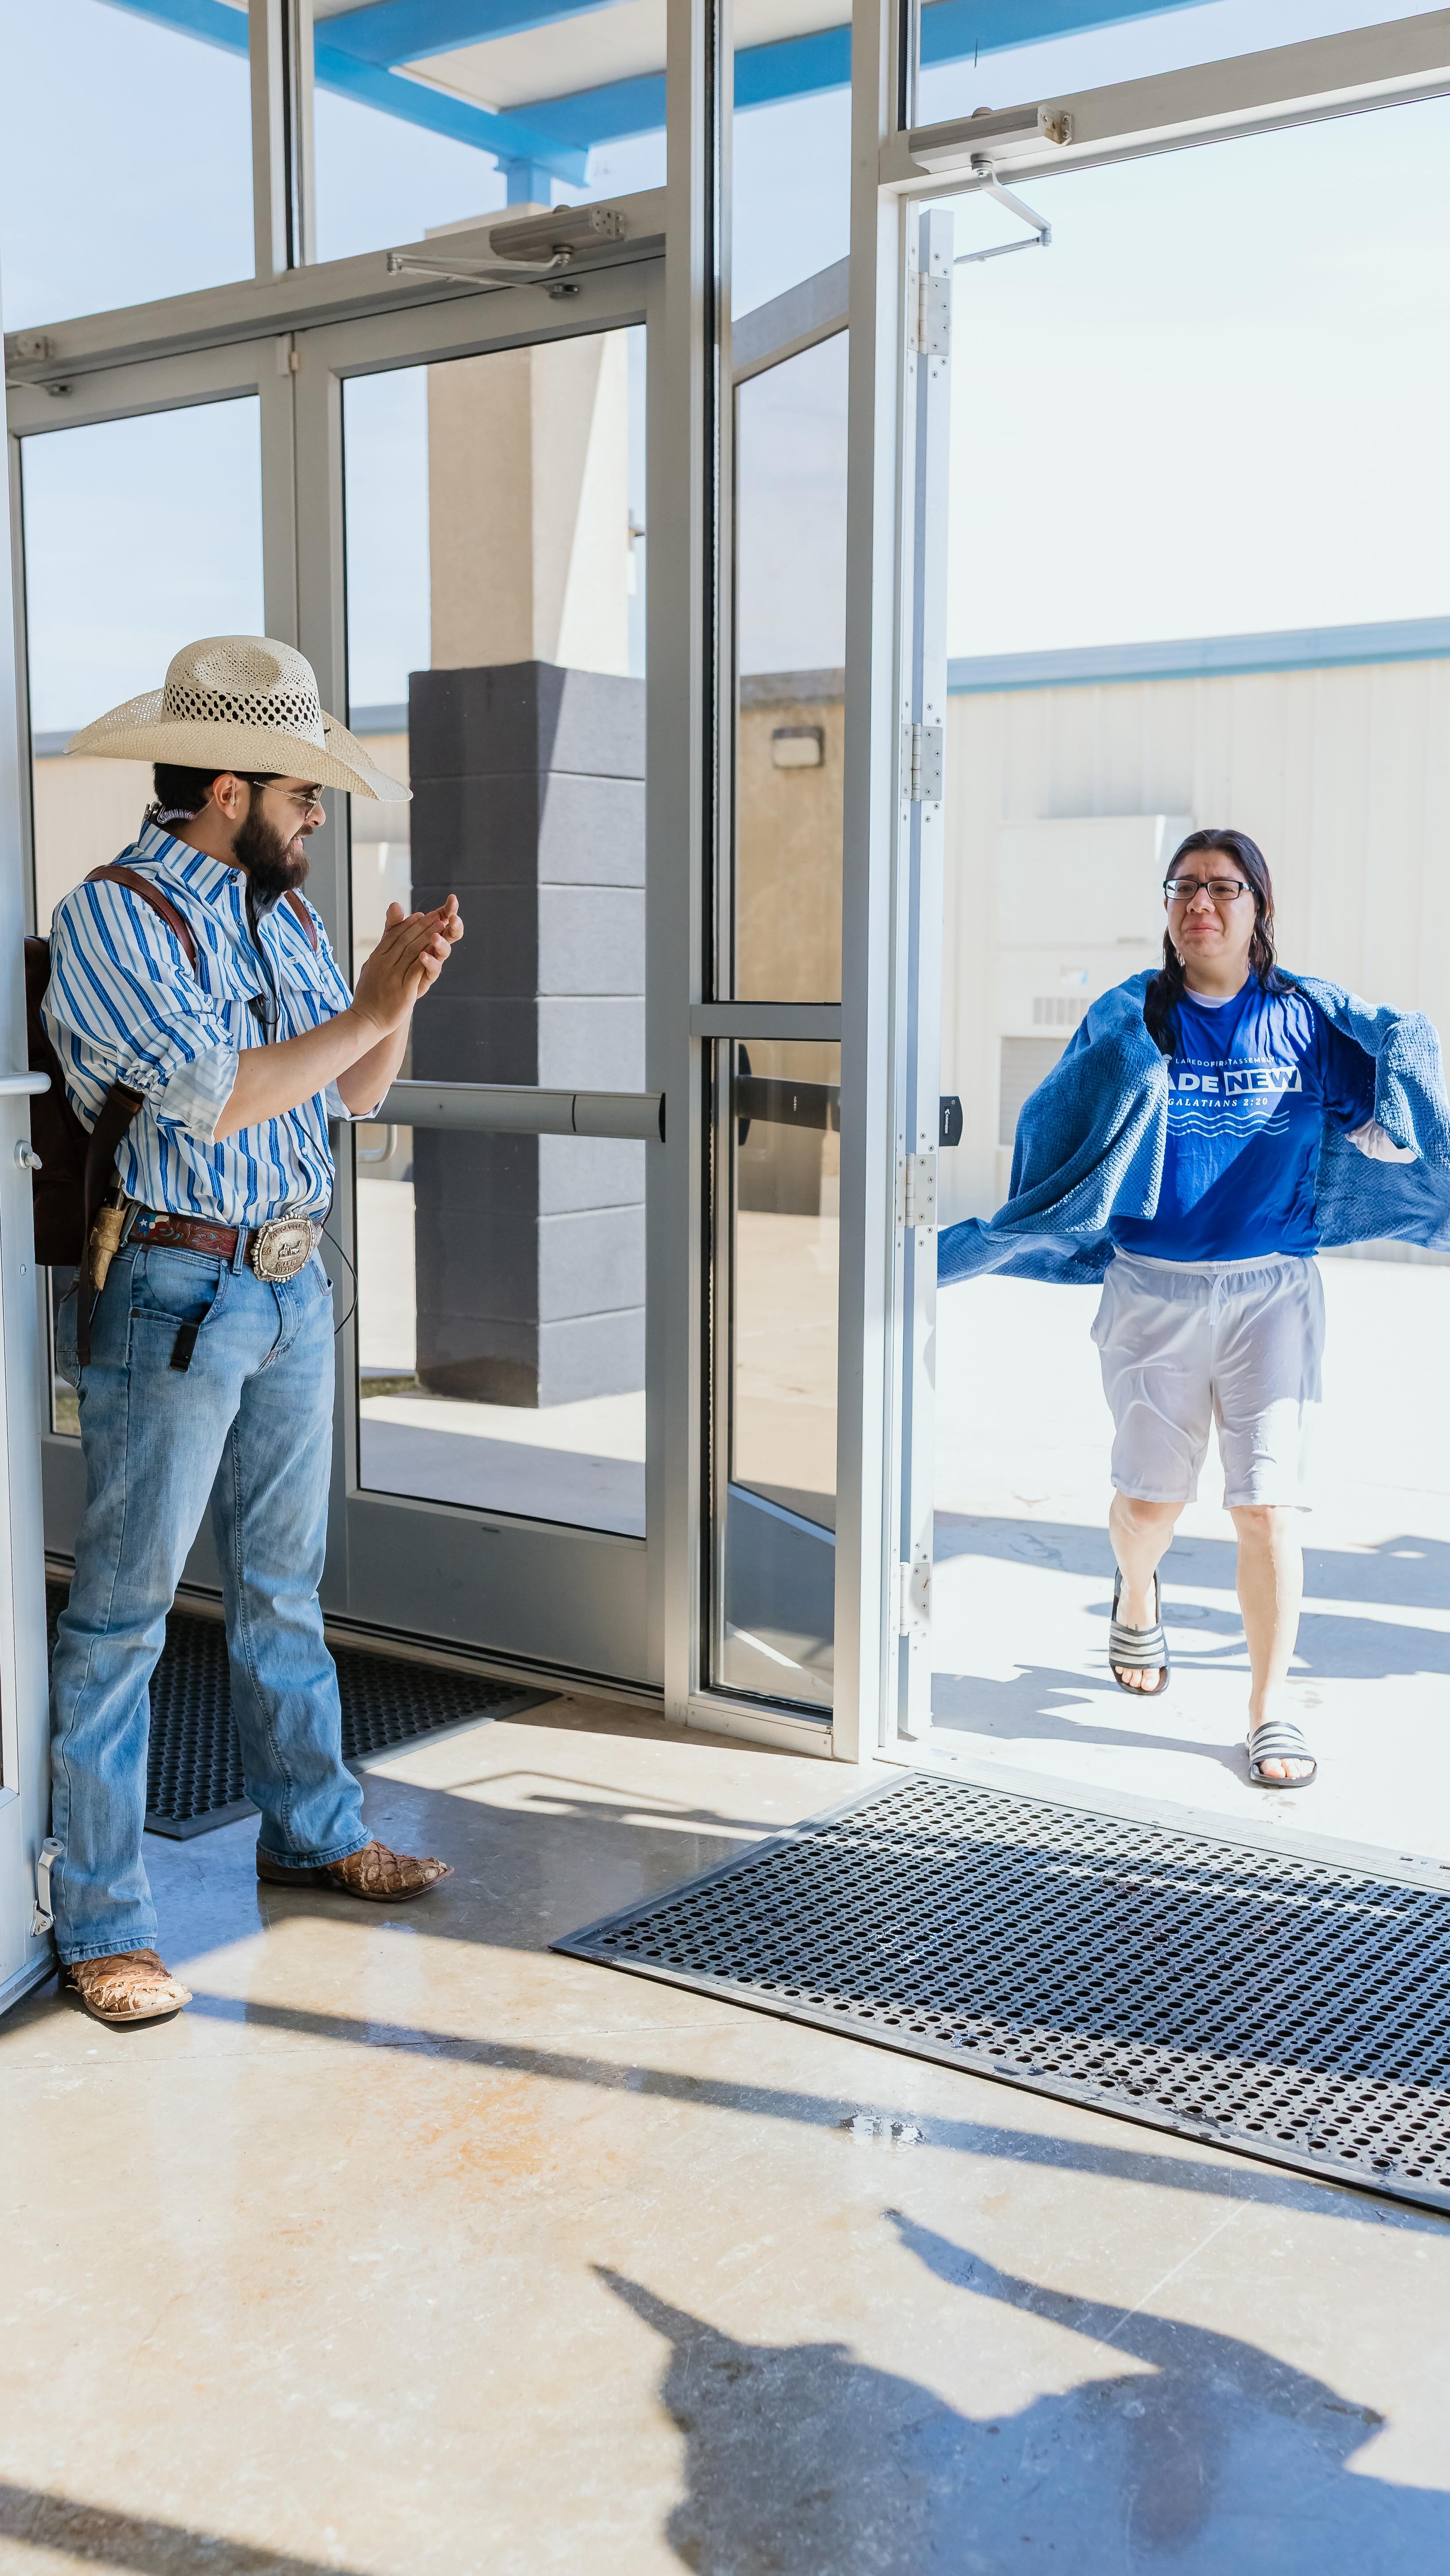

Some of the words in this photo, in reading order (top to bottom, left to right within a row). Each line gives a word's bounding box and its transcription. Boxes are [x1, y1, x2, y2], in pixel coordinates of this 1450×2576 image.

[1167, 1072, 1219, 1093] DE
[1227, 1069, 1298, 1093] NEW
[1168, 1098, 1237, 1107] GALATIANS
[1243, 1097, 1268, 1107] 2:20
